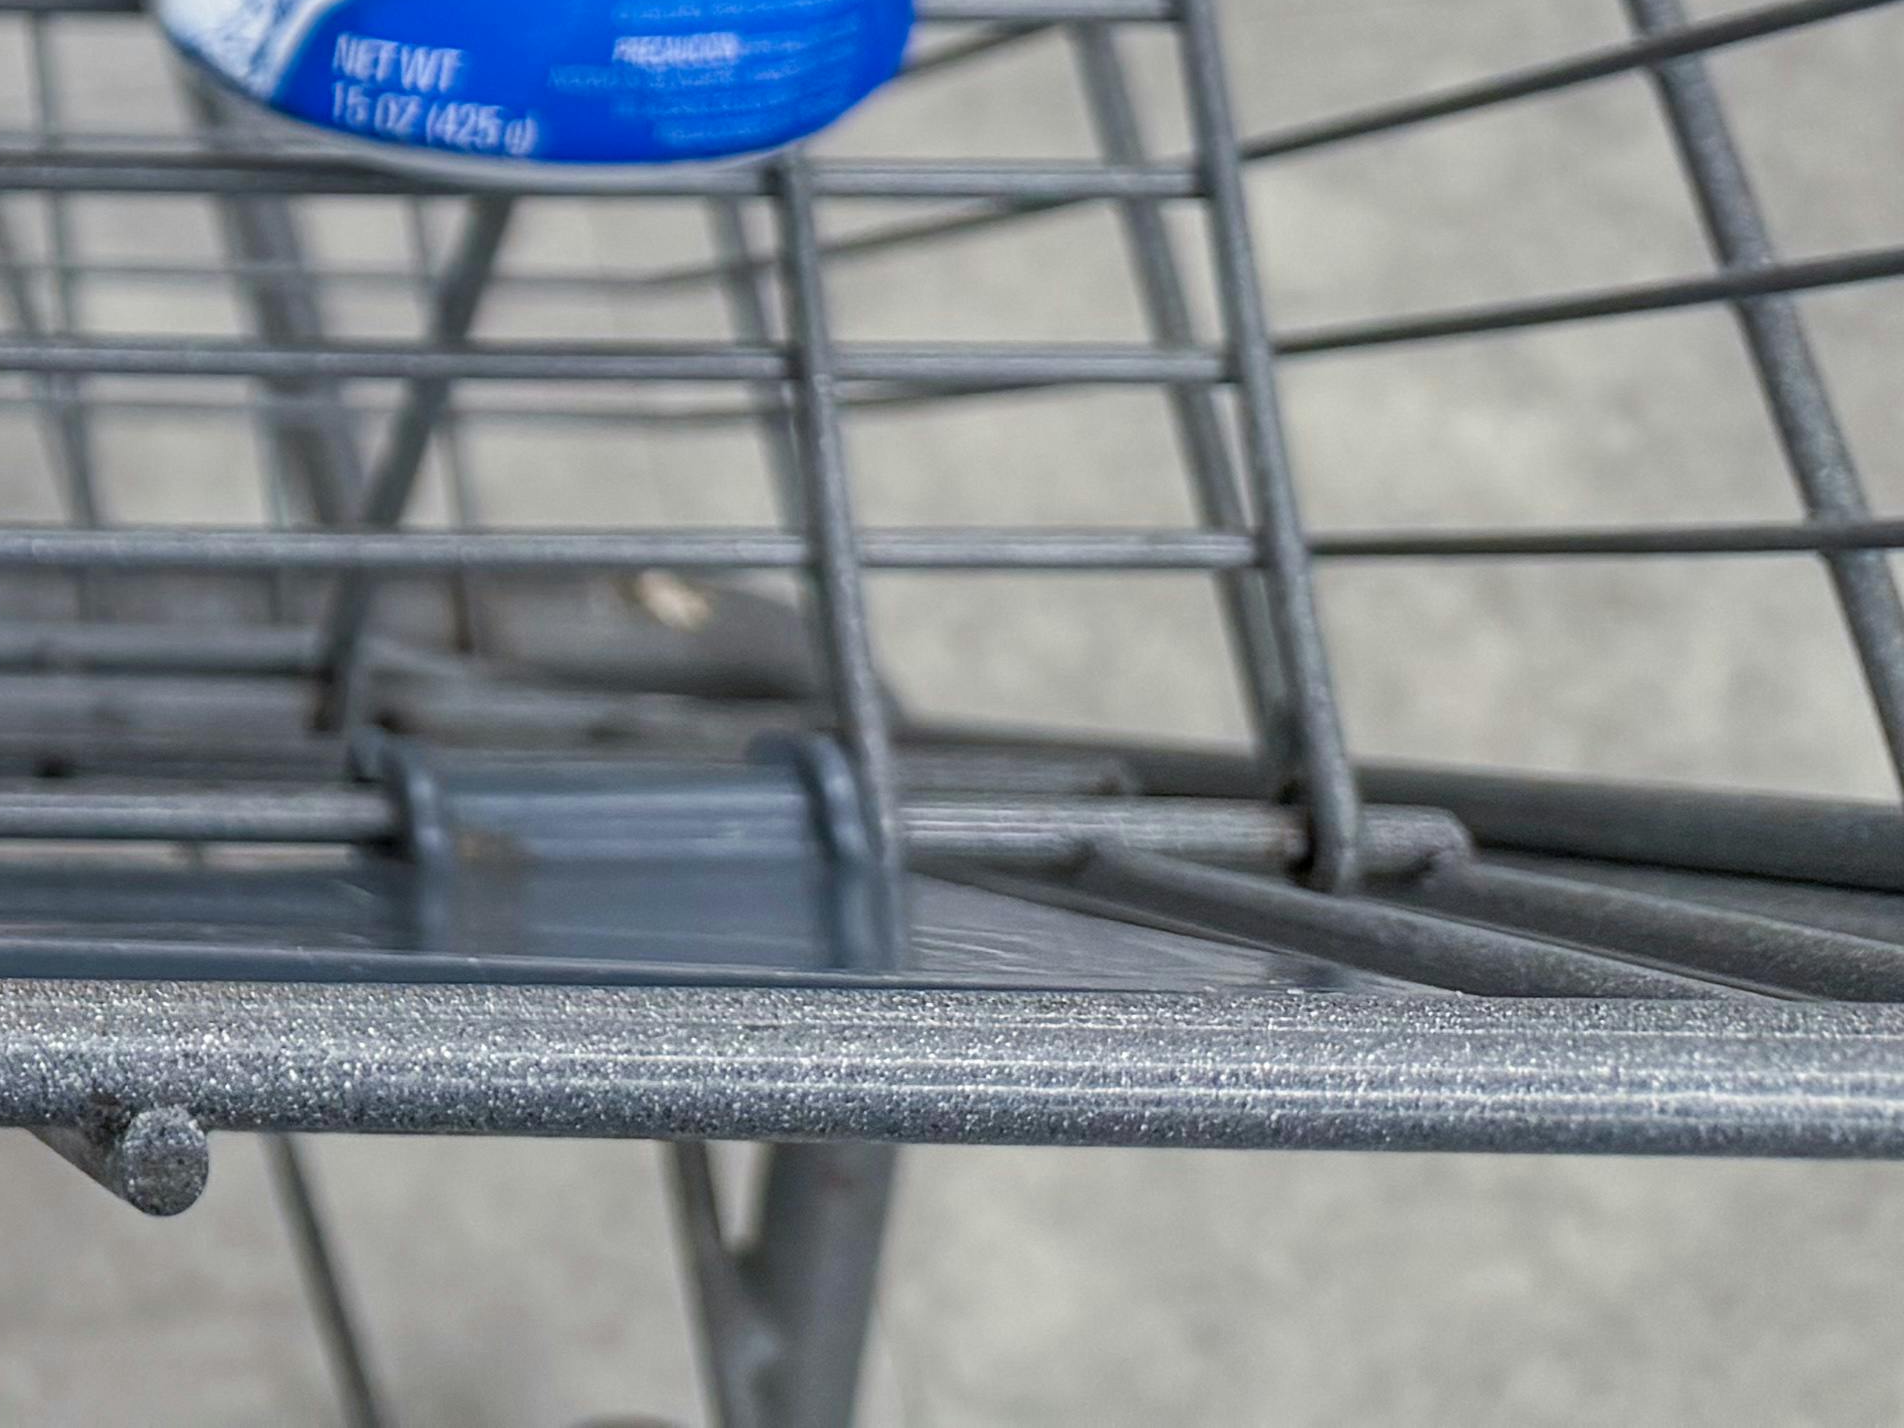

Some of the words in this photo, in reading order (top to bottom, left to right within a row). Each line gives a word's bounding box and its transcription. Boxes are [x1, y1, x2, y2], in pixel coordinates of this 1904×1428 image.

[333, 33, 400, 82] NET
[401, 42, 467, 93] WT
[331, 79, 369, 126] 15
[373, 92, 422, 137] OZ
